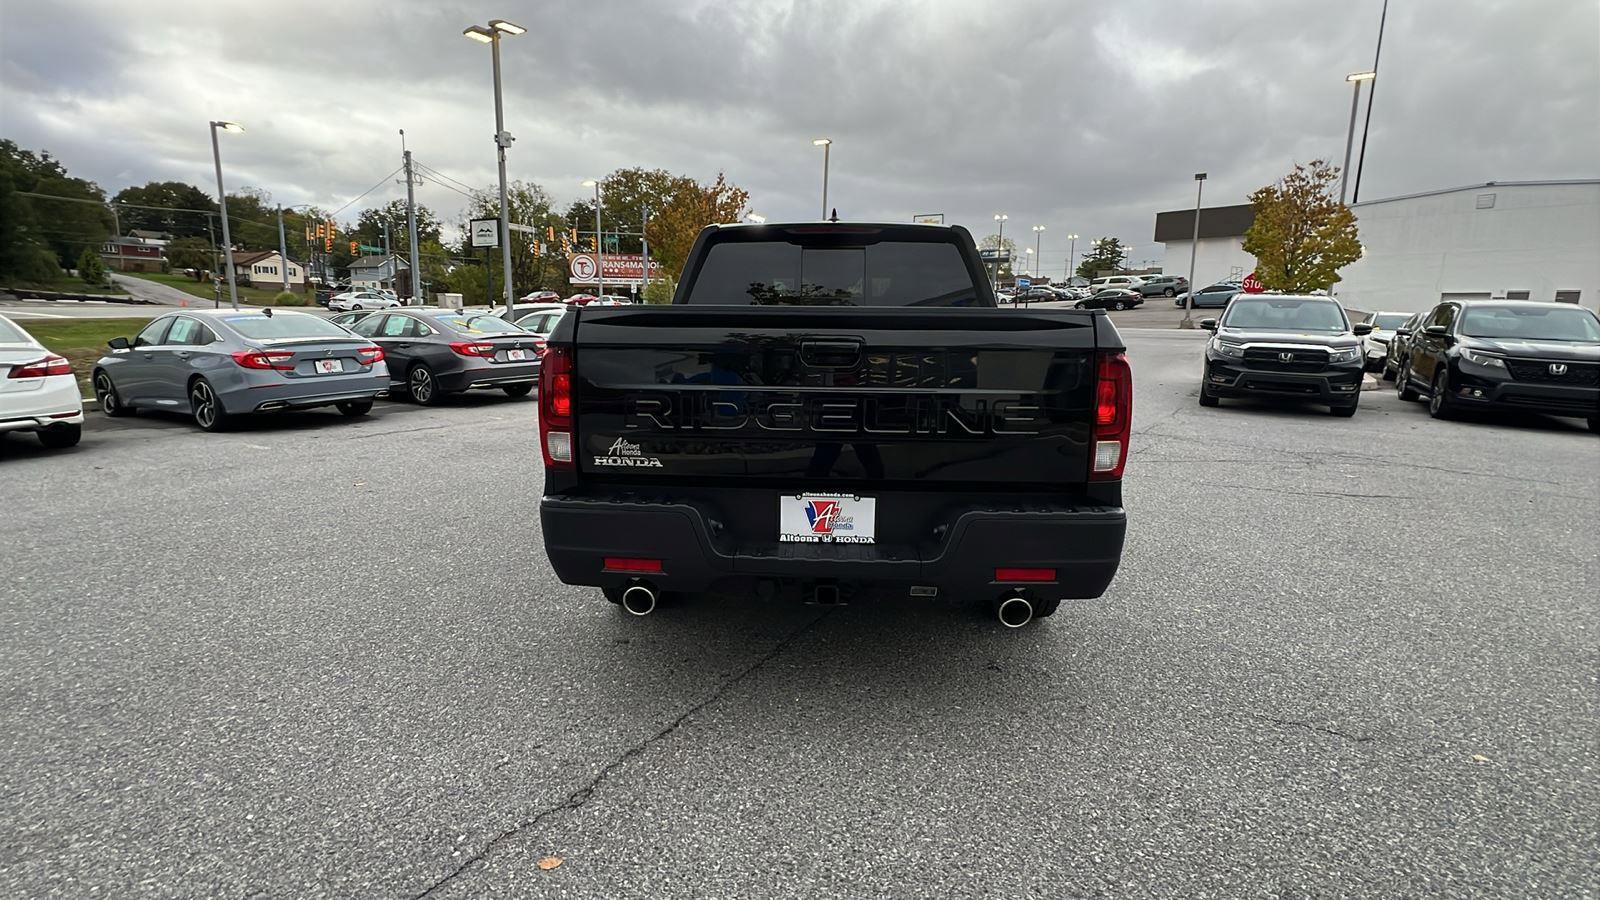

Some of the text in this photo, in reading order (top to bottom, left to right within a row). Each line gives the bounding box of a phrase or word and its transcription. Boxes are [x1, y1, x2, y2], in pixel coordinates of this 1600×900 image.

[600, 261, 661, 269] RANS4MAIO
[1243, 279, 1264, 289] STO
[625, 394, 1040, 435] RIDGELINE
[593, 456, 663, 468] HONDA
[780, 534, 819, 542] Altoona
